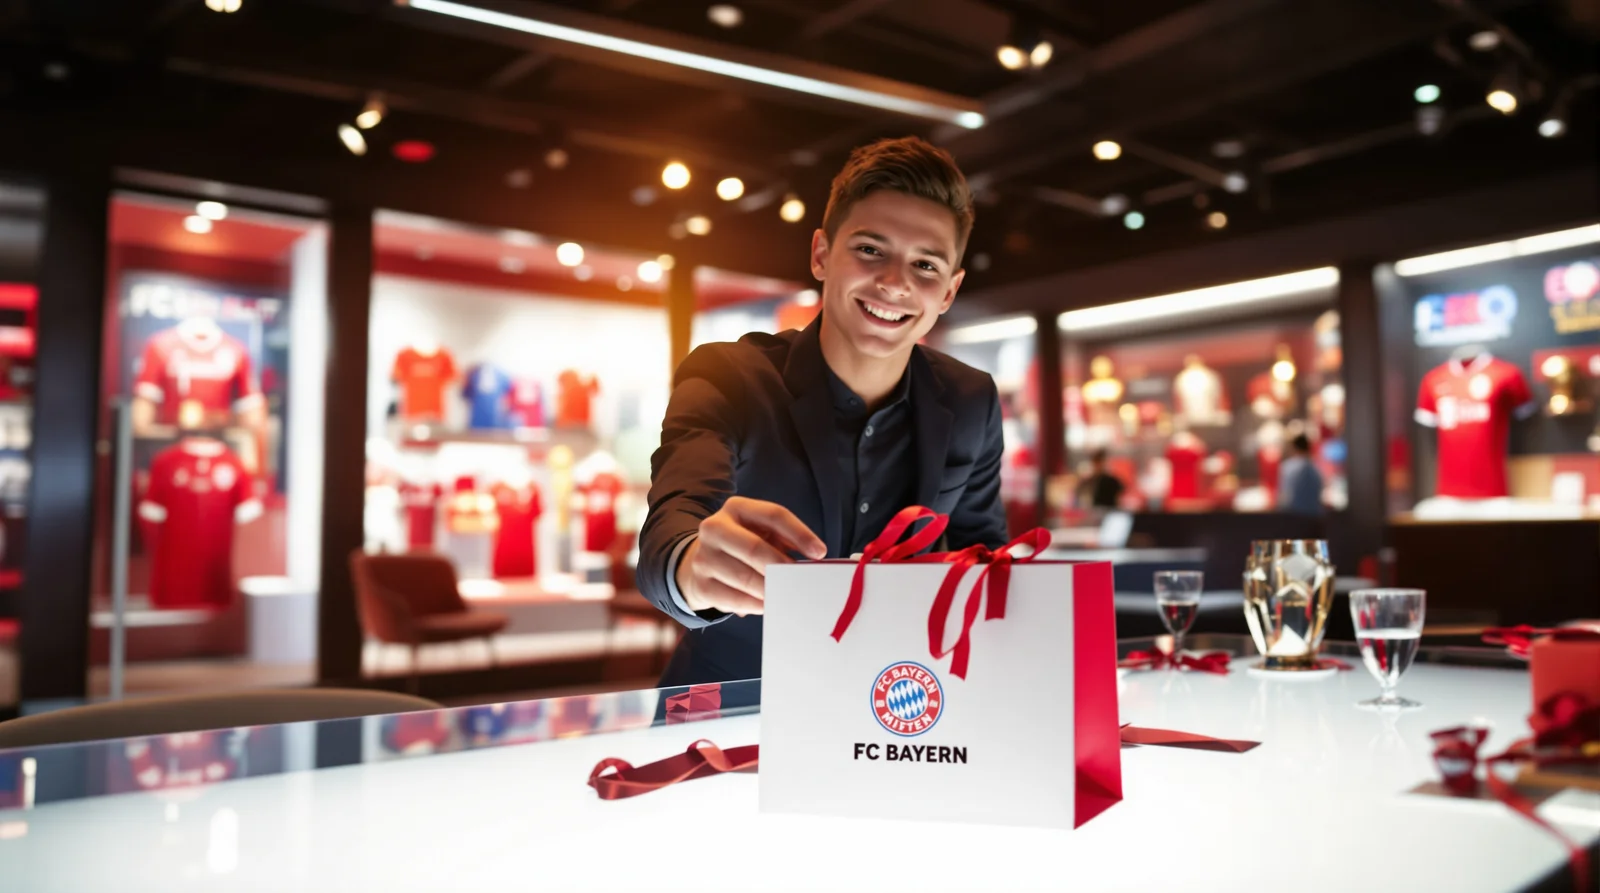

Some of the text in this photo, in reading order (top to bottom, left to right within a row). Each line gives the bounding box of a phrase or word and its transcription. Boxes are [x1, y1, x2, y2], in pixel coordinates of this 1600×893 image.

[877, 667, 937, 694] FC BAYERN
[854, 743, 967, 764] FC BAYERN
